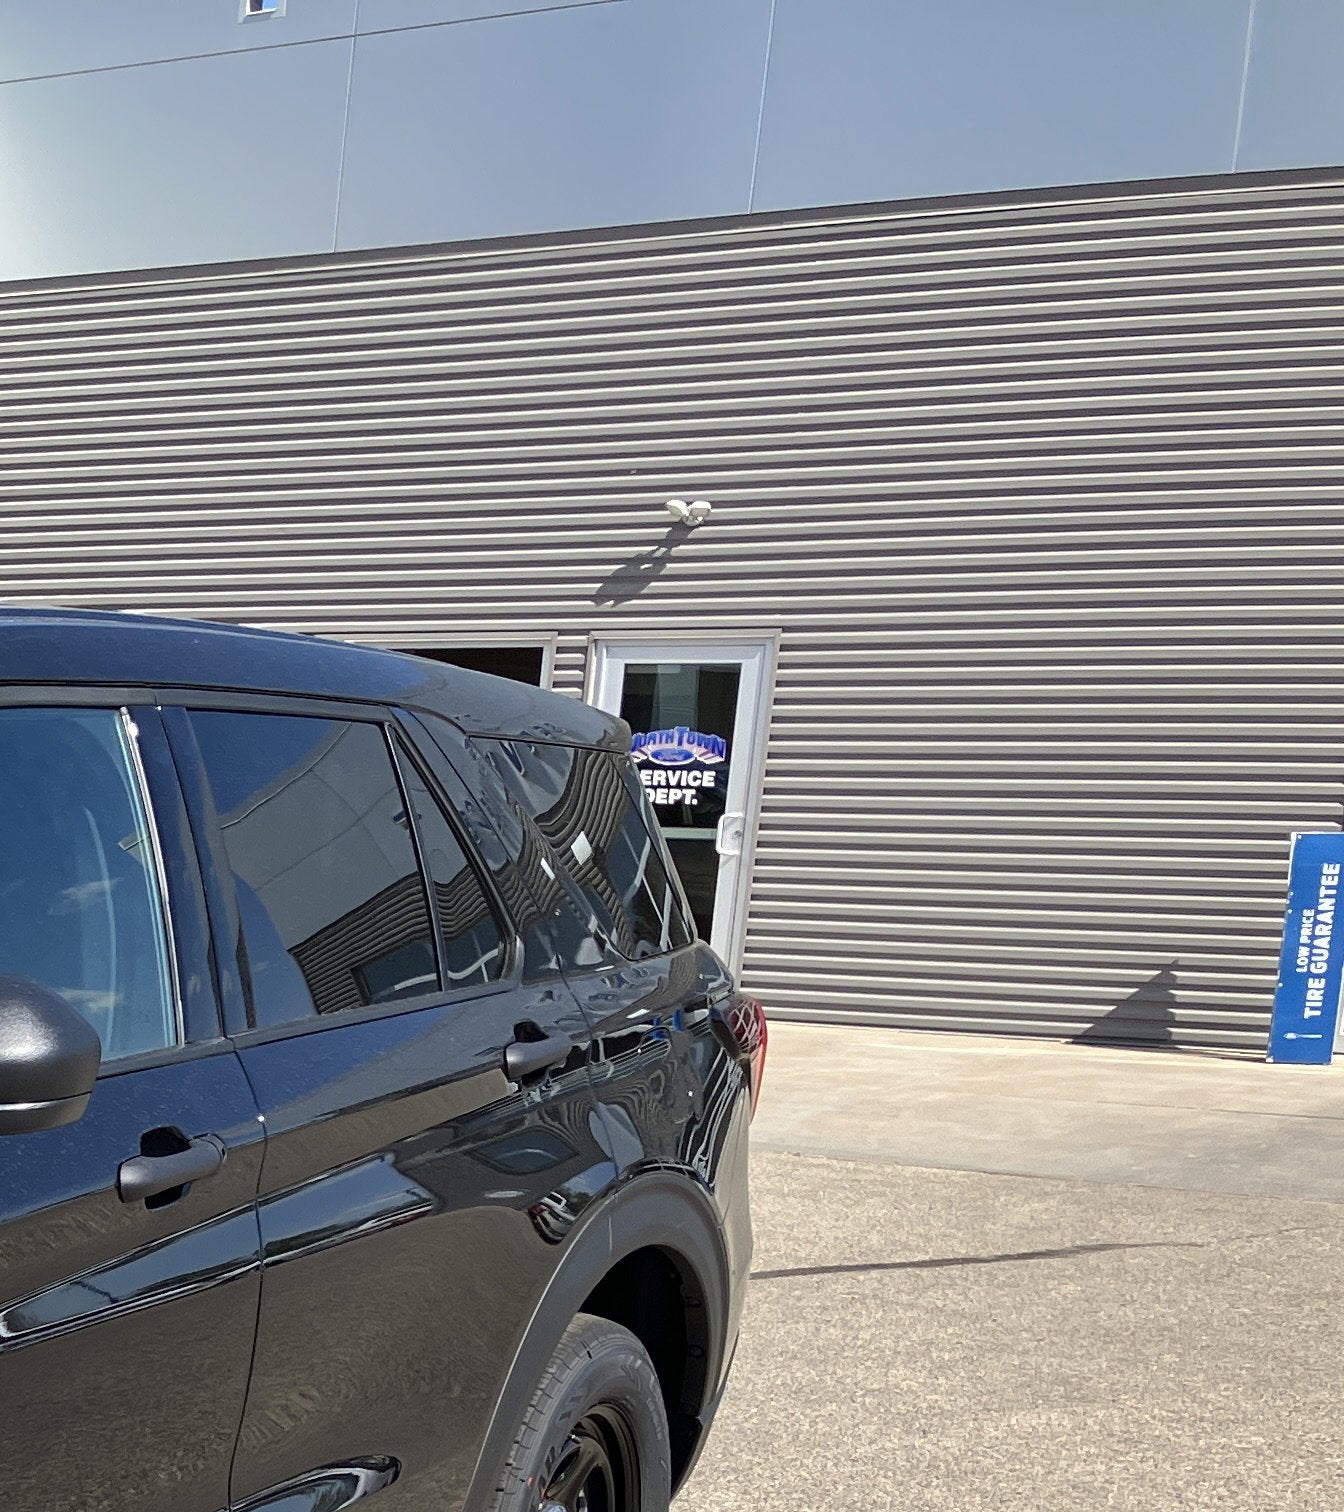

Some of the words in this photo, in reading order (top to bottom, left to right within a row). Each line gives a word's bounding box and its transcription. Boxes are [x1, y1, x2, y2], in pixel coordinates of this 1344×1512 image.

[674, 725, 725, 758] TOWN
[640, 770, 716, 787] ERVICE
[1299, 909, 1315, 944] PRICE
[1310, 863, 1341, 974] GUARANTEE
[1295, 944, 1311, 973] LOW
[1304, 977, 1326, 1020] TIRE
